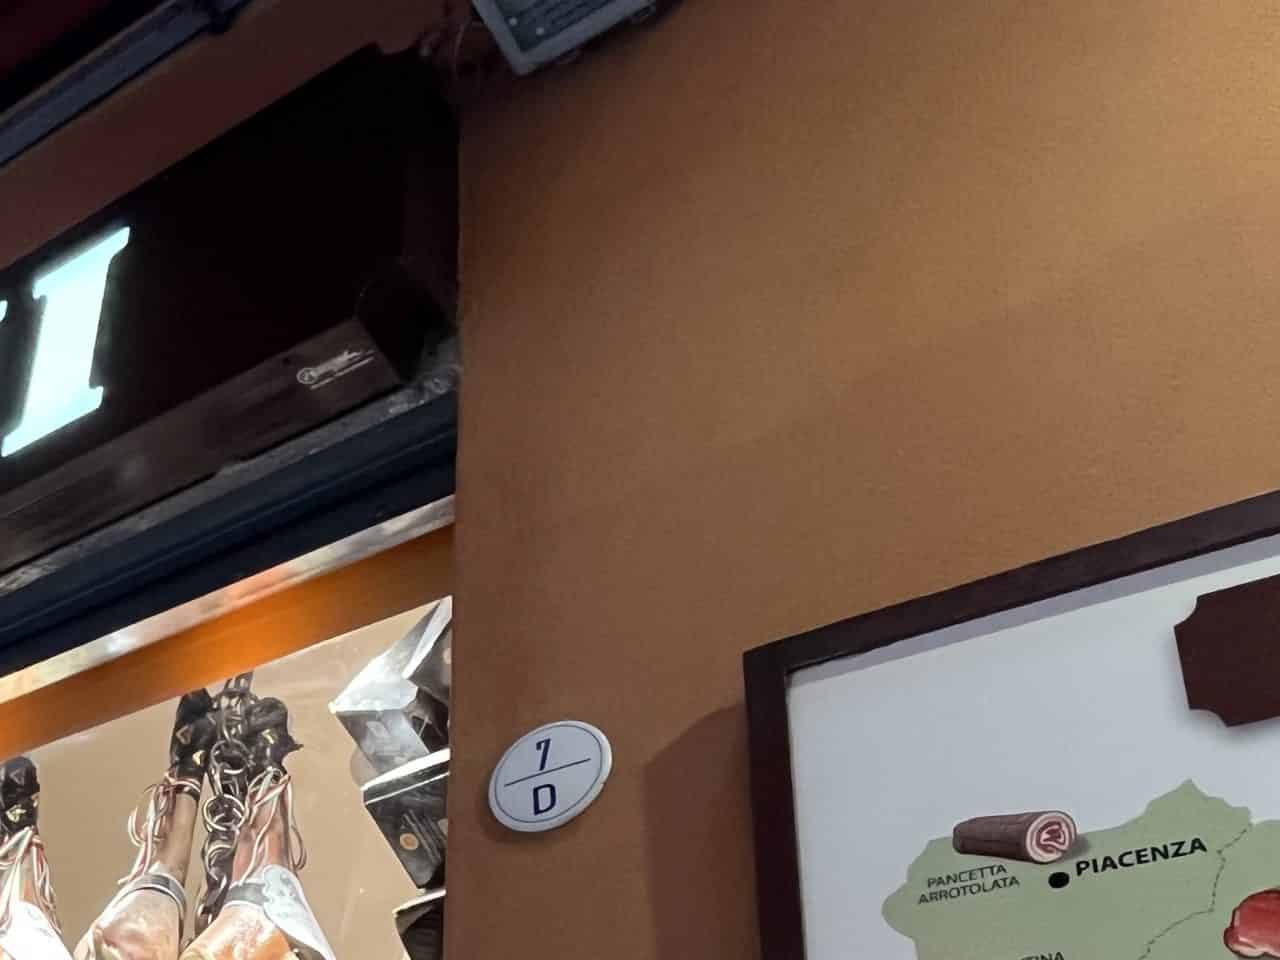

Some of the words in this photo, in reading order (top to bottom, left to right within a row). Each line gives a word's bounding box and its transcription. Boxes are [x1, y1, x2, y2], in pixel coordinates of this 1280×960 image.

[535, 738, 551, 771] 7
[532, 783, 557, 816] D
[1075, 837, 1208, 877] PIACENZA
[917, 875, 1020, 905] ARROTOLATA
[926, 863, 1008, 889] PANCETTA
